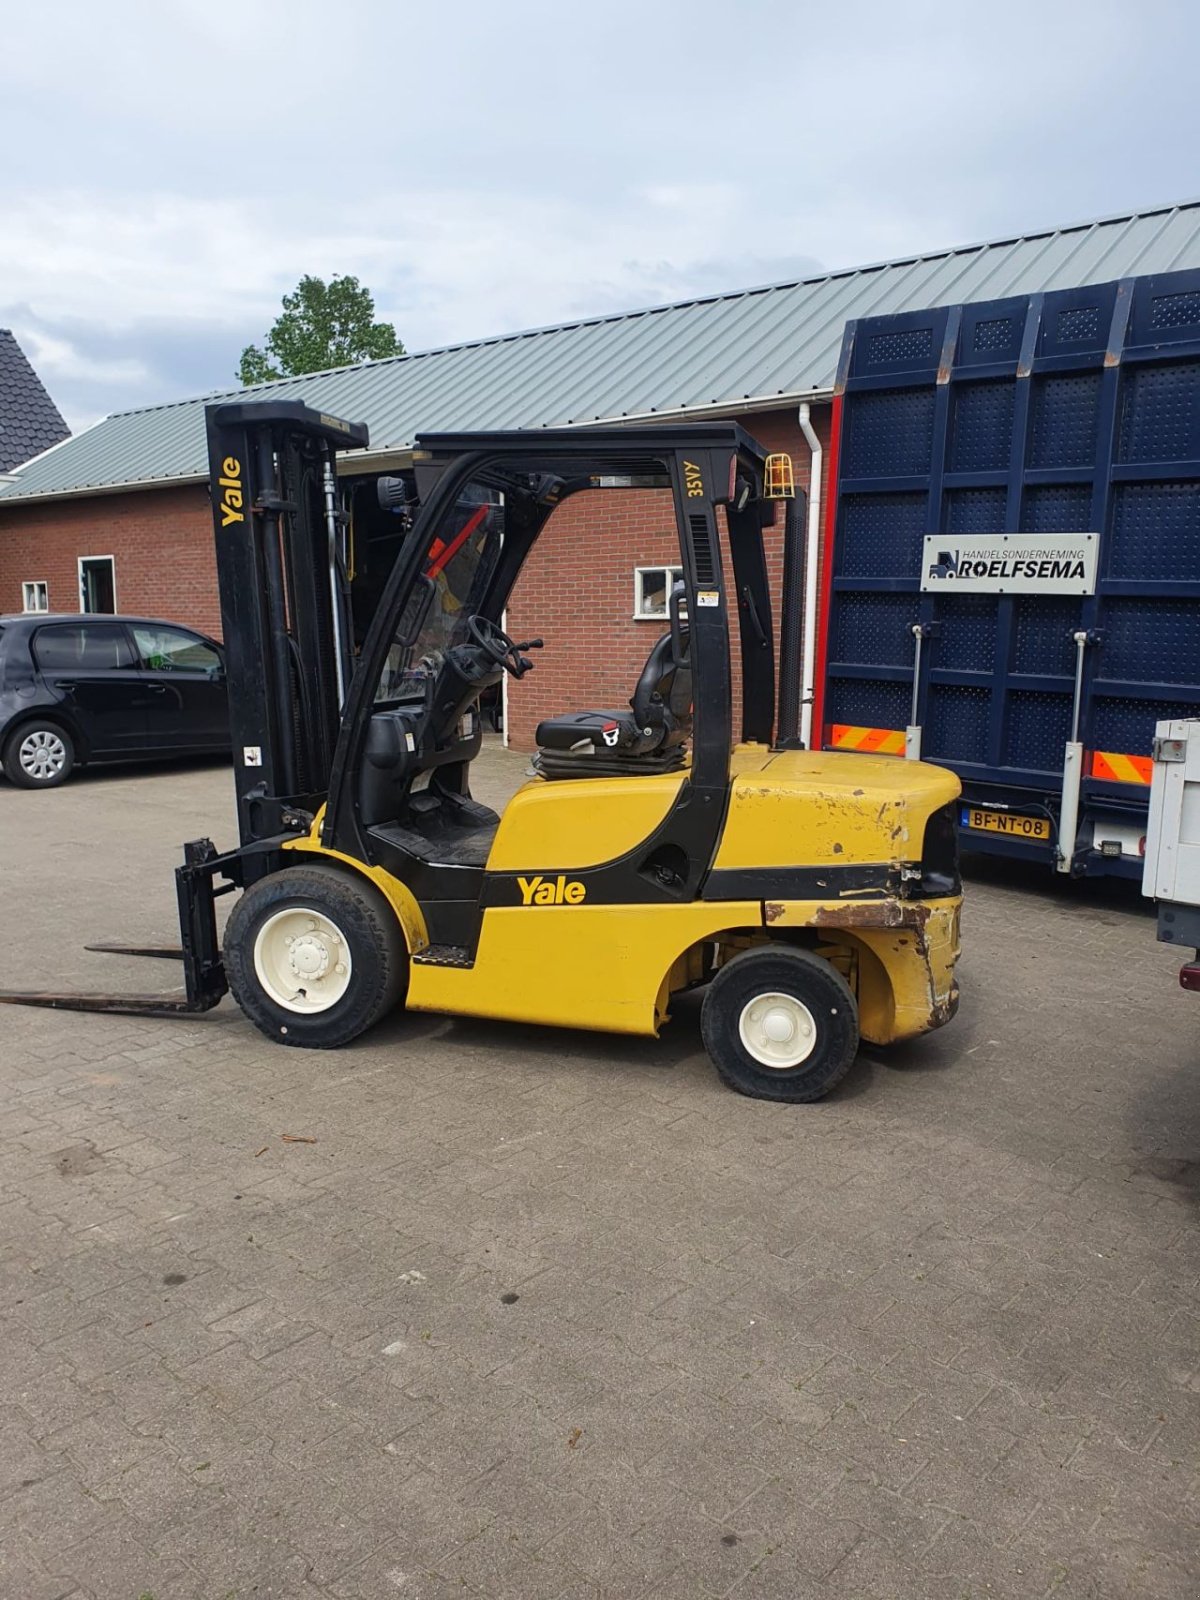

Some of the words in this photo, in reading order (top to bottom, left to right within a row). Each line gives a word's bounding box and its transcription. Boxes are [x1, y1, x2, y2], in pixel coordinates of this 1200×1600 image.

[219, 456, 244, 527] Yale
[962, 550, 1085, 560] HANDELSONDERNEMING
[959, 560, 1085, 578] ROELFSEMA
[974, 812, 1044, 835] BF-NT-08
[517, 875, 586, 905] Yale
